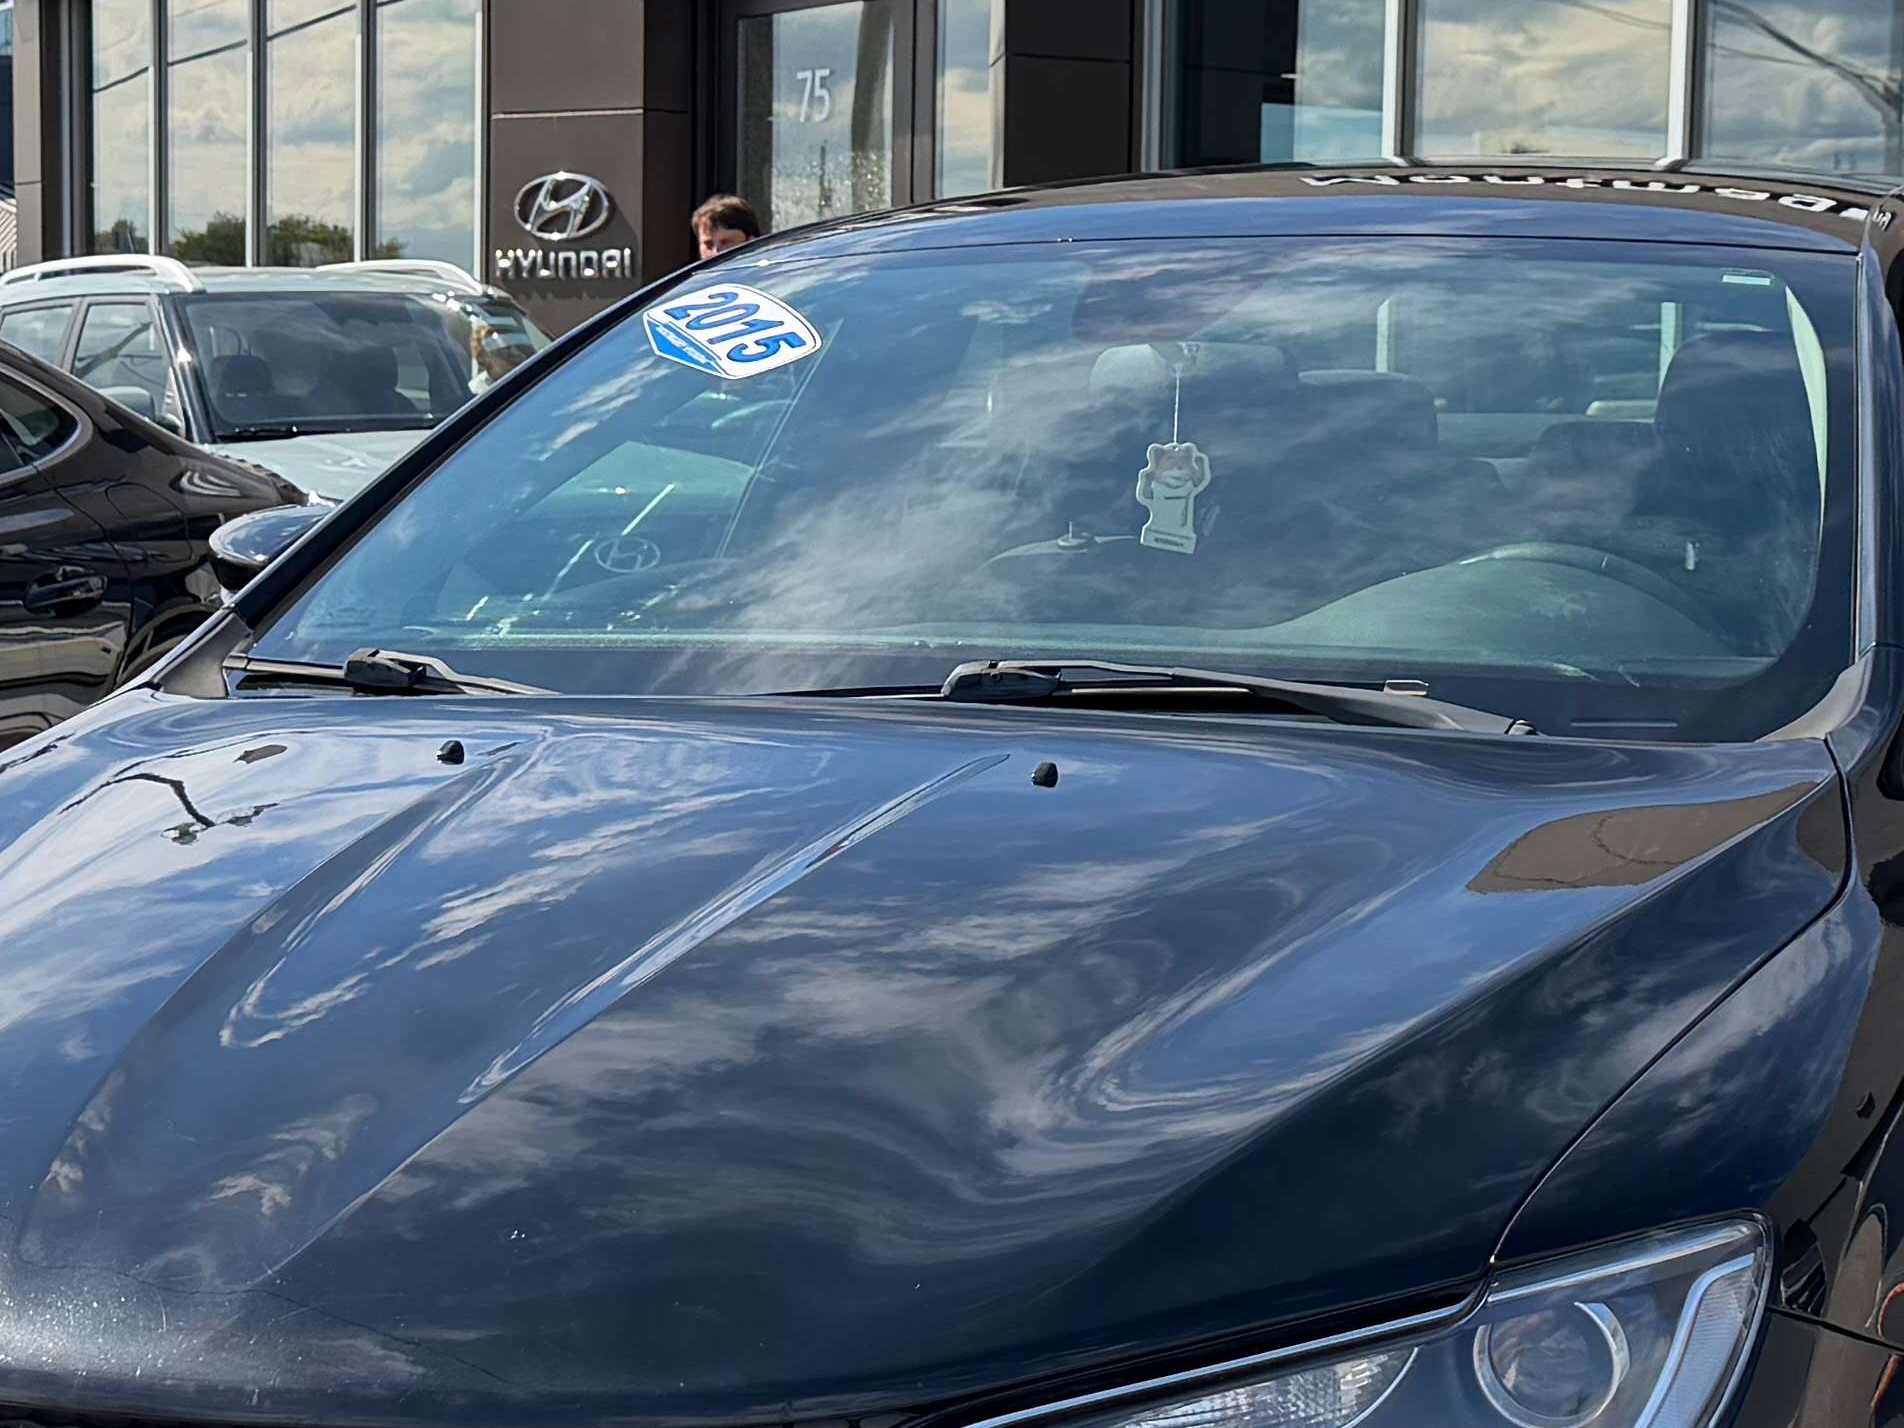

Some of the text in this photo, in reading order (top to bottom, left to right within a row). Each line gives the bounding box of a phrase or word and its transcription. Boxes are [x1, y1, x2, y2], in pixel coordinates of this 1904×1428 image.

[796, 67, 831, 123] 75
[495, 247, 632, 279] HYUNDAI
[662, 290, 808, 364] 2015
